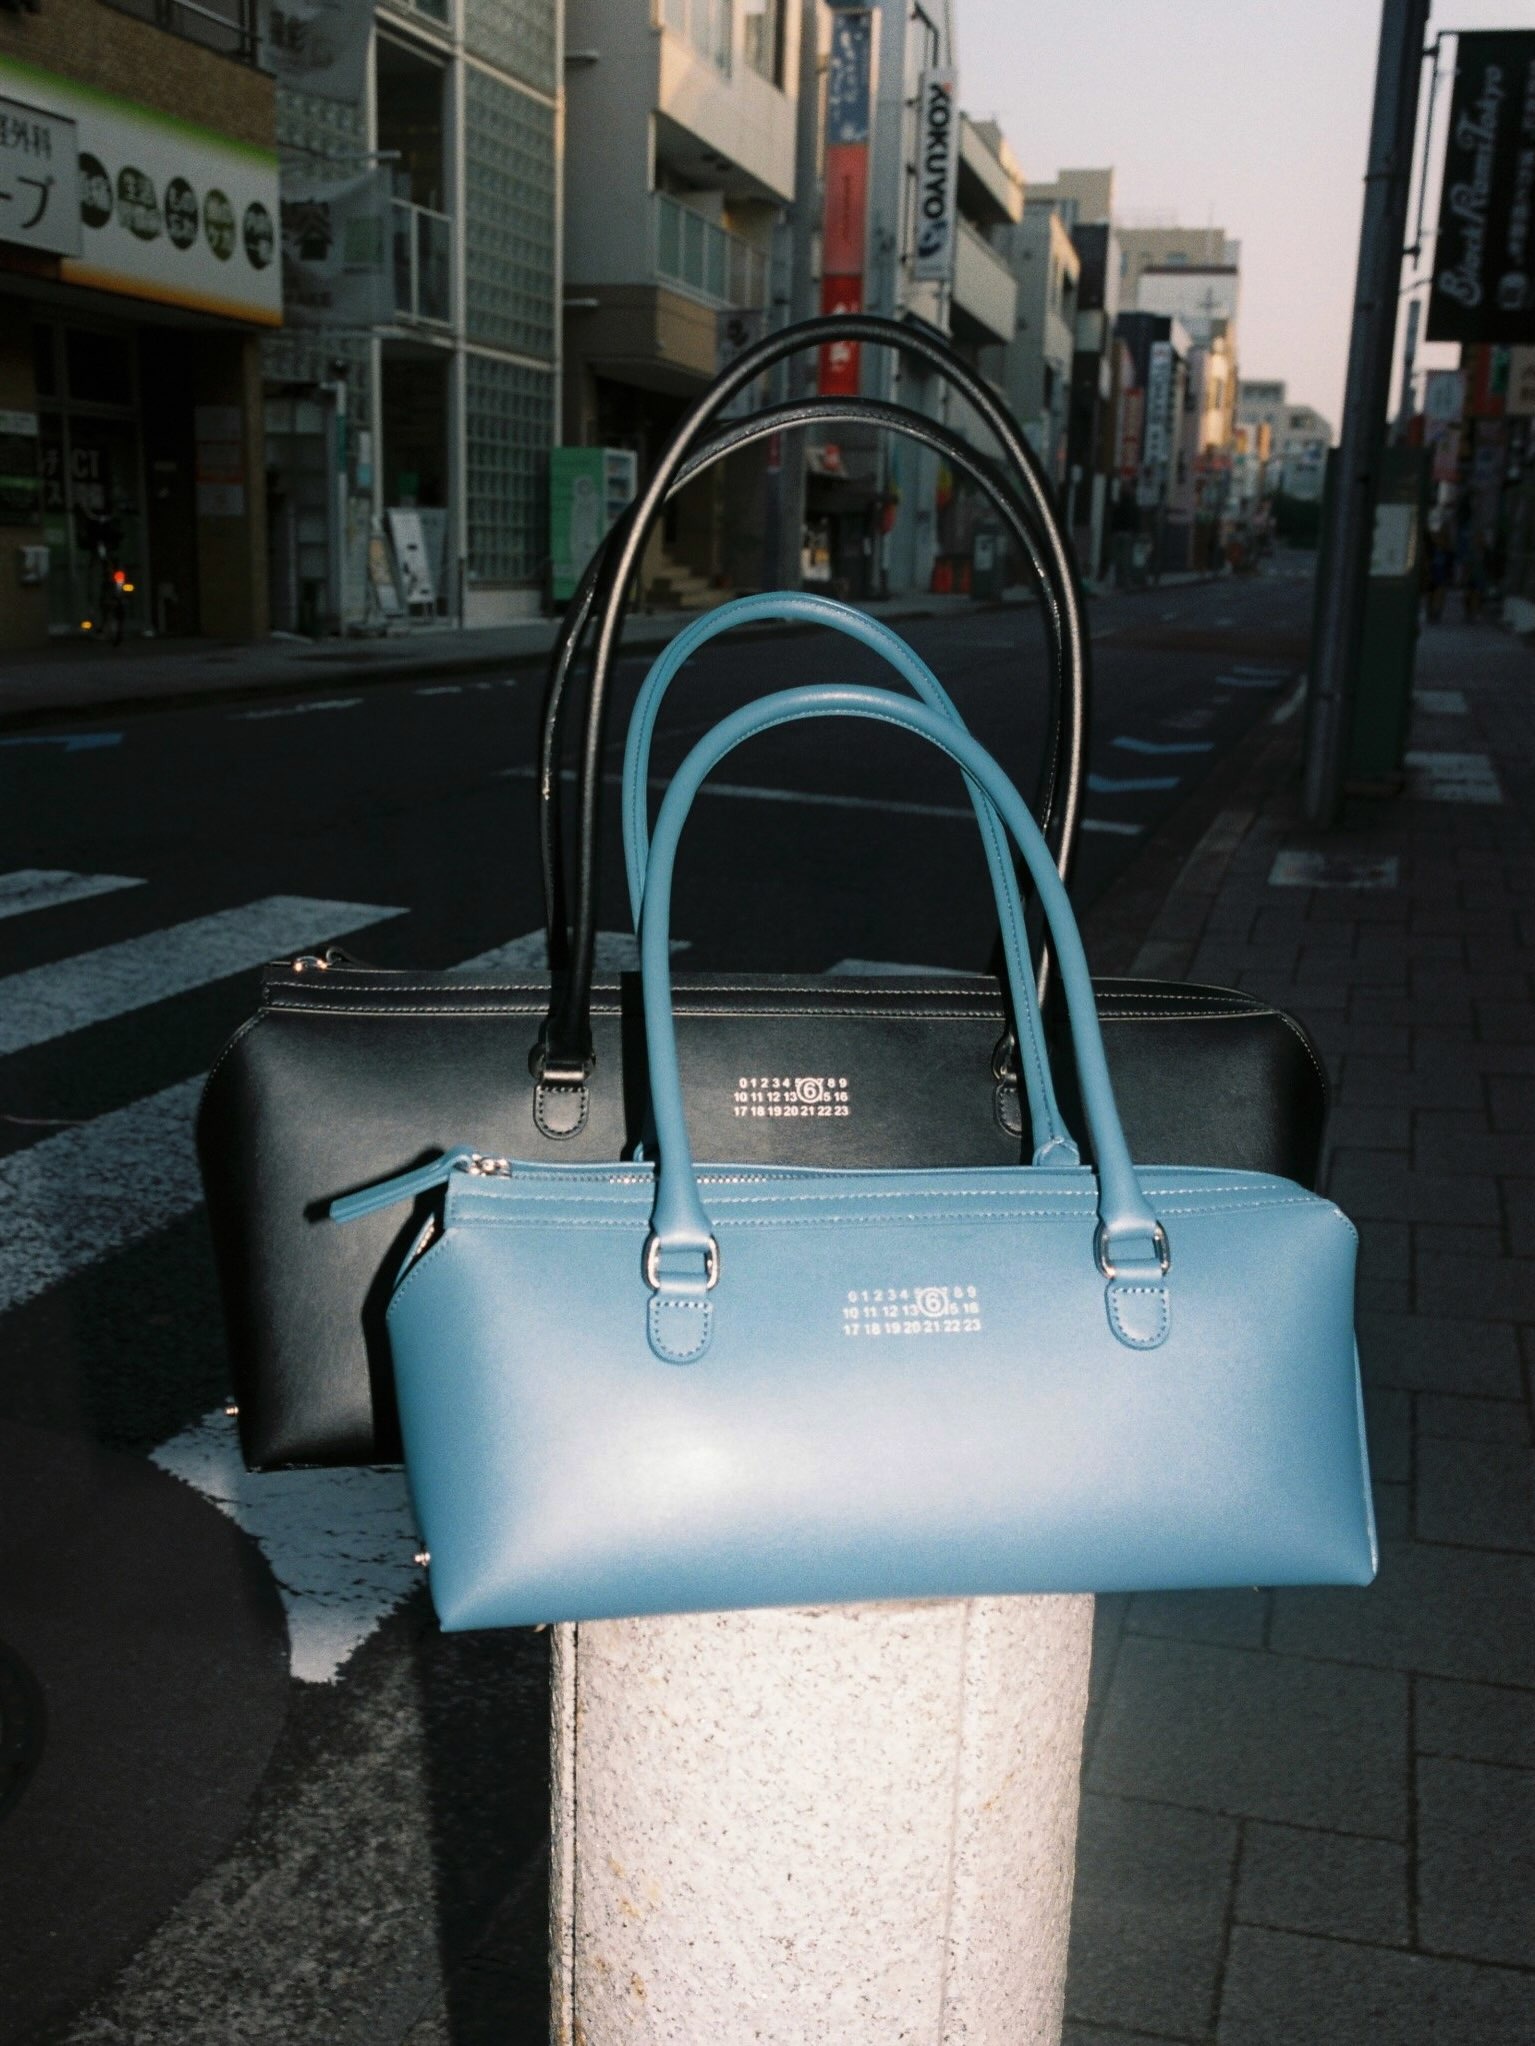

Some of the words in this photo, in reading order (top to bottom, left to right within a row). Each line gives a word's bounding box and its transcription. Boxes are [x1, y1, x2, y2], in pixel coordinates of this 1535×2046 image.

[923, 84, 950, 219] KOKUYO
[739, 1077, 748, 1088] 0
[750, 1077, 757, 1088] 1
[761, 1077, 769, 1088] 2
[772, 1077, 780, 1088] 3
[782, 1077, 791, 1088] 4
[827, 1077, 836, 1088] 8
[839, 1077, 848, 1088] 9
[734, 1091, 747, 1102] 10
[750, 1091, 763, 1102] 11
[767, 1091, 780, 1102] 12
[783, 1091, 797, 1102] 13
[834, 1091, 848, 1102] 16
[734, 1105, 747, 1116] 17
[750, 1105, 765, 1116] 18
[768, 1105, 781, 1116] 19
[783, 1105, 798, 1116] 20
[800, 1105, 814, 1116] 21
[817, 1105, 832, 1116] 22
[834, 1105, 849, 1116] 23
[861, 1290, 868, 1302] 1
[873, 1289, 883, 1302] 2
[888, 1288, 897, 1301] 3
[899, 1288, 908, 1300] 4
[843, 1306, 859, 1319] 10
[863, 1305, 877, 1318] 11
[882, 1304, 898, 1317] 12
[902, 1304, 919, 1316] 13
[843, 1323, 859, 1336] 17
[864, 1322, 881, 1335] 18
[884, 1321, 901, 1334] 19
[903, 1320, 921, 1334] 20
[923, 1319, 940, 1333] 21
[943, 1319, 960, 1332] 22
[963, 1318, 982, 1332] 23
